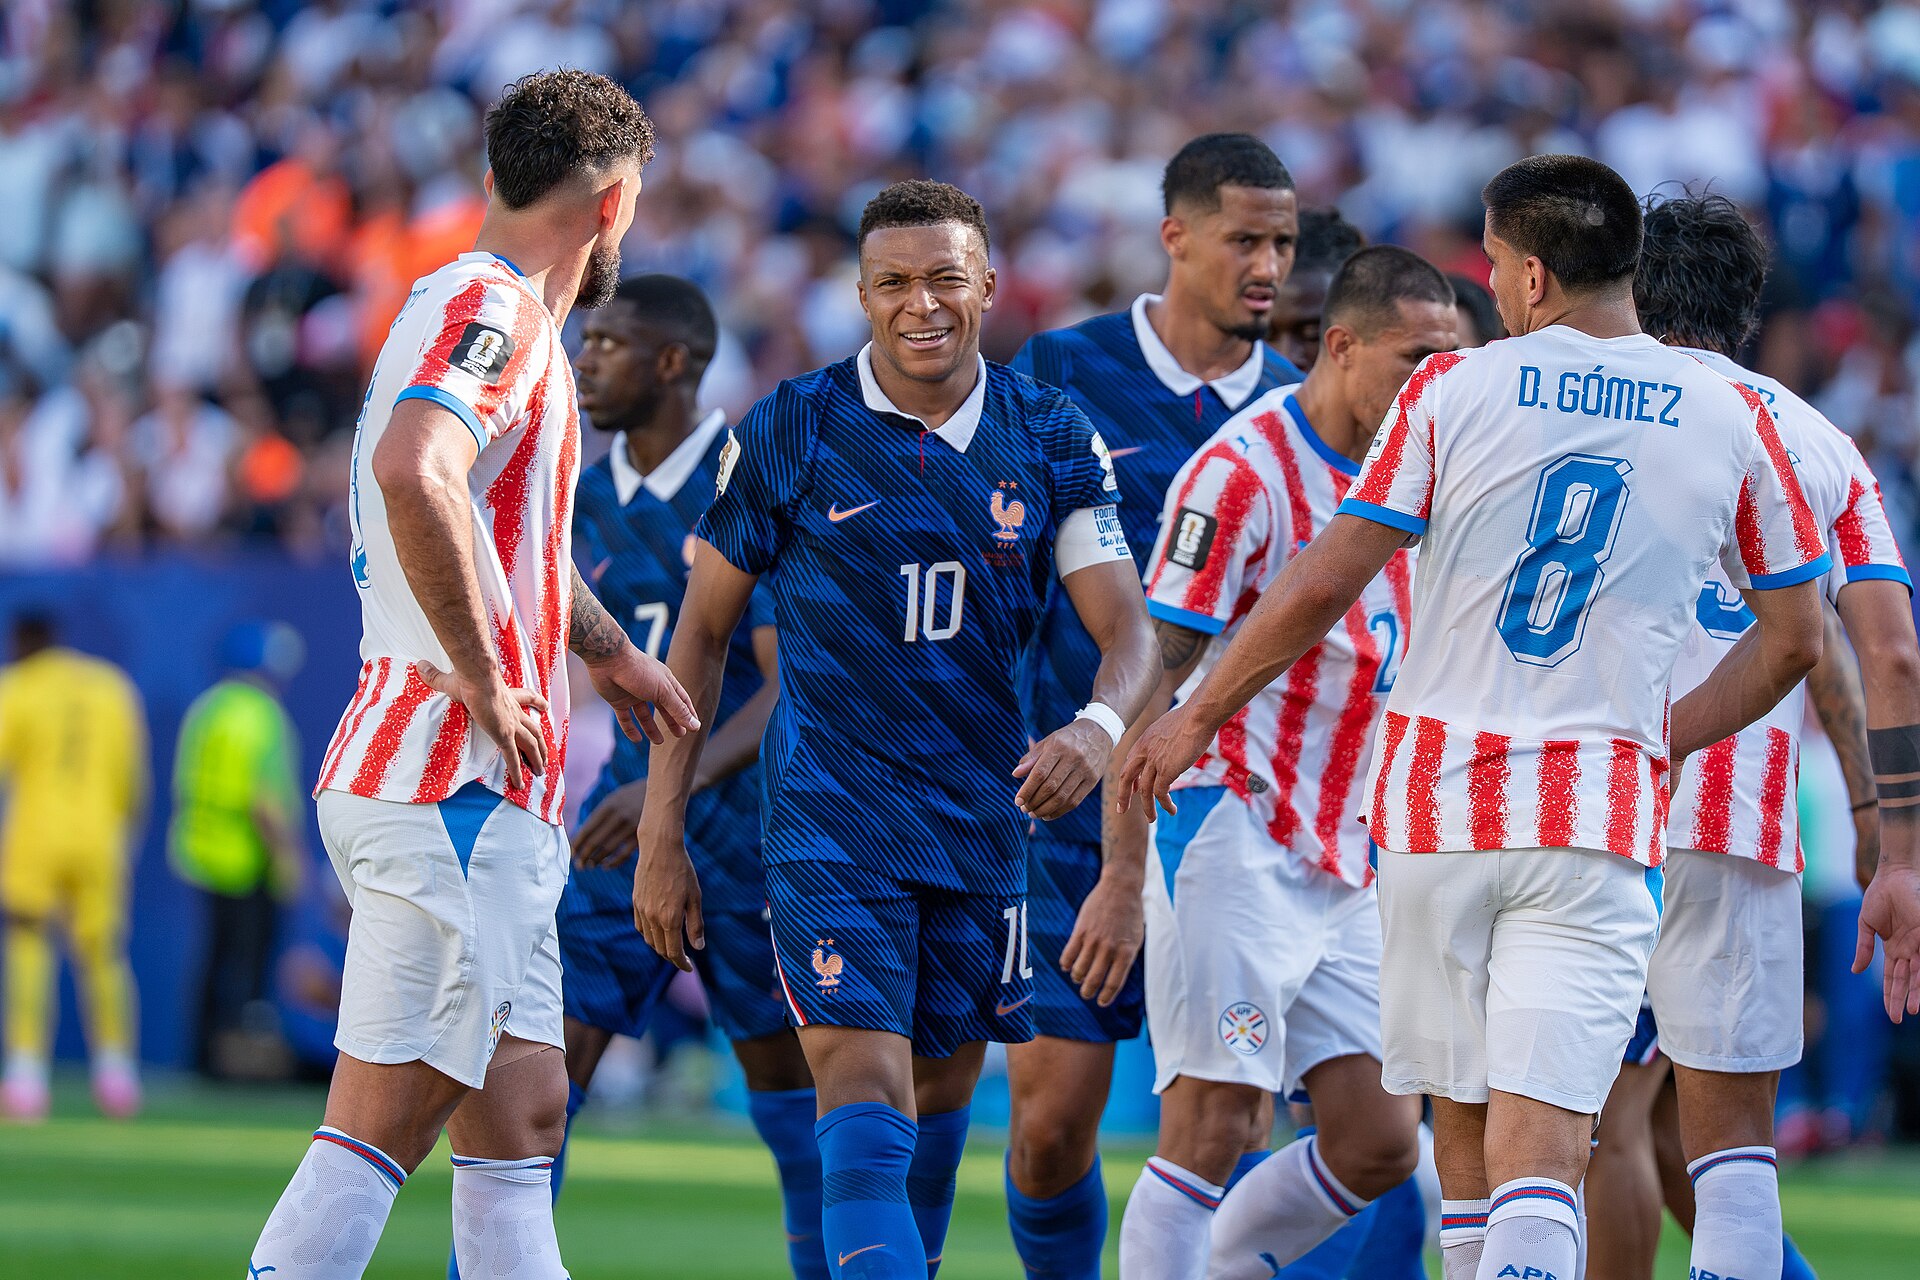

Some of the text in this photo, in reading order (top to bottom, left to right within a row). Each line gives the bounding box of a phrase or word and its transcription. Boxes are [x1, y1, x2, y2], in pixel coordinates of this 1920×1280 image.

[1518, 365, 1549, 410] D.
[1556, 364, 1683, 428] GÓMEZ
[1495, 451, 1634, 668] 8
[634, 601, 669, 659] 7
[900, 560, 966, 642] 10
